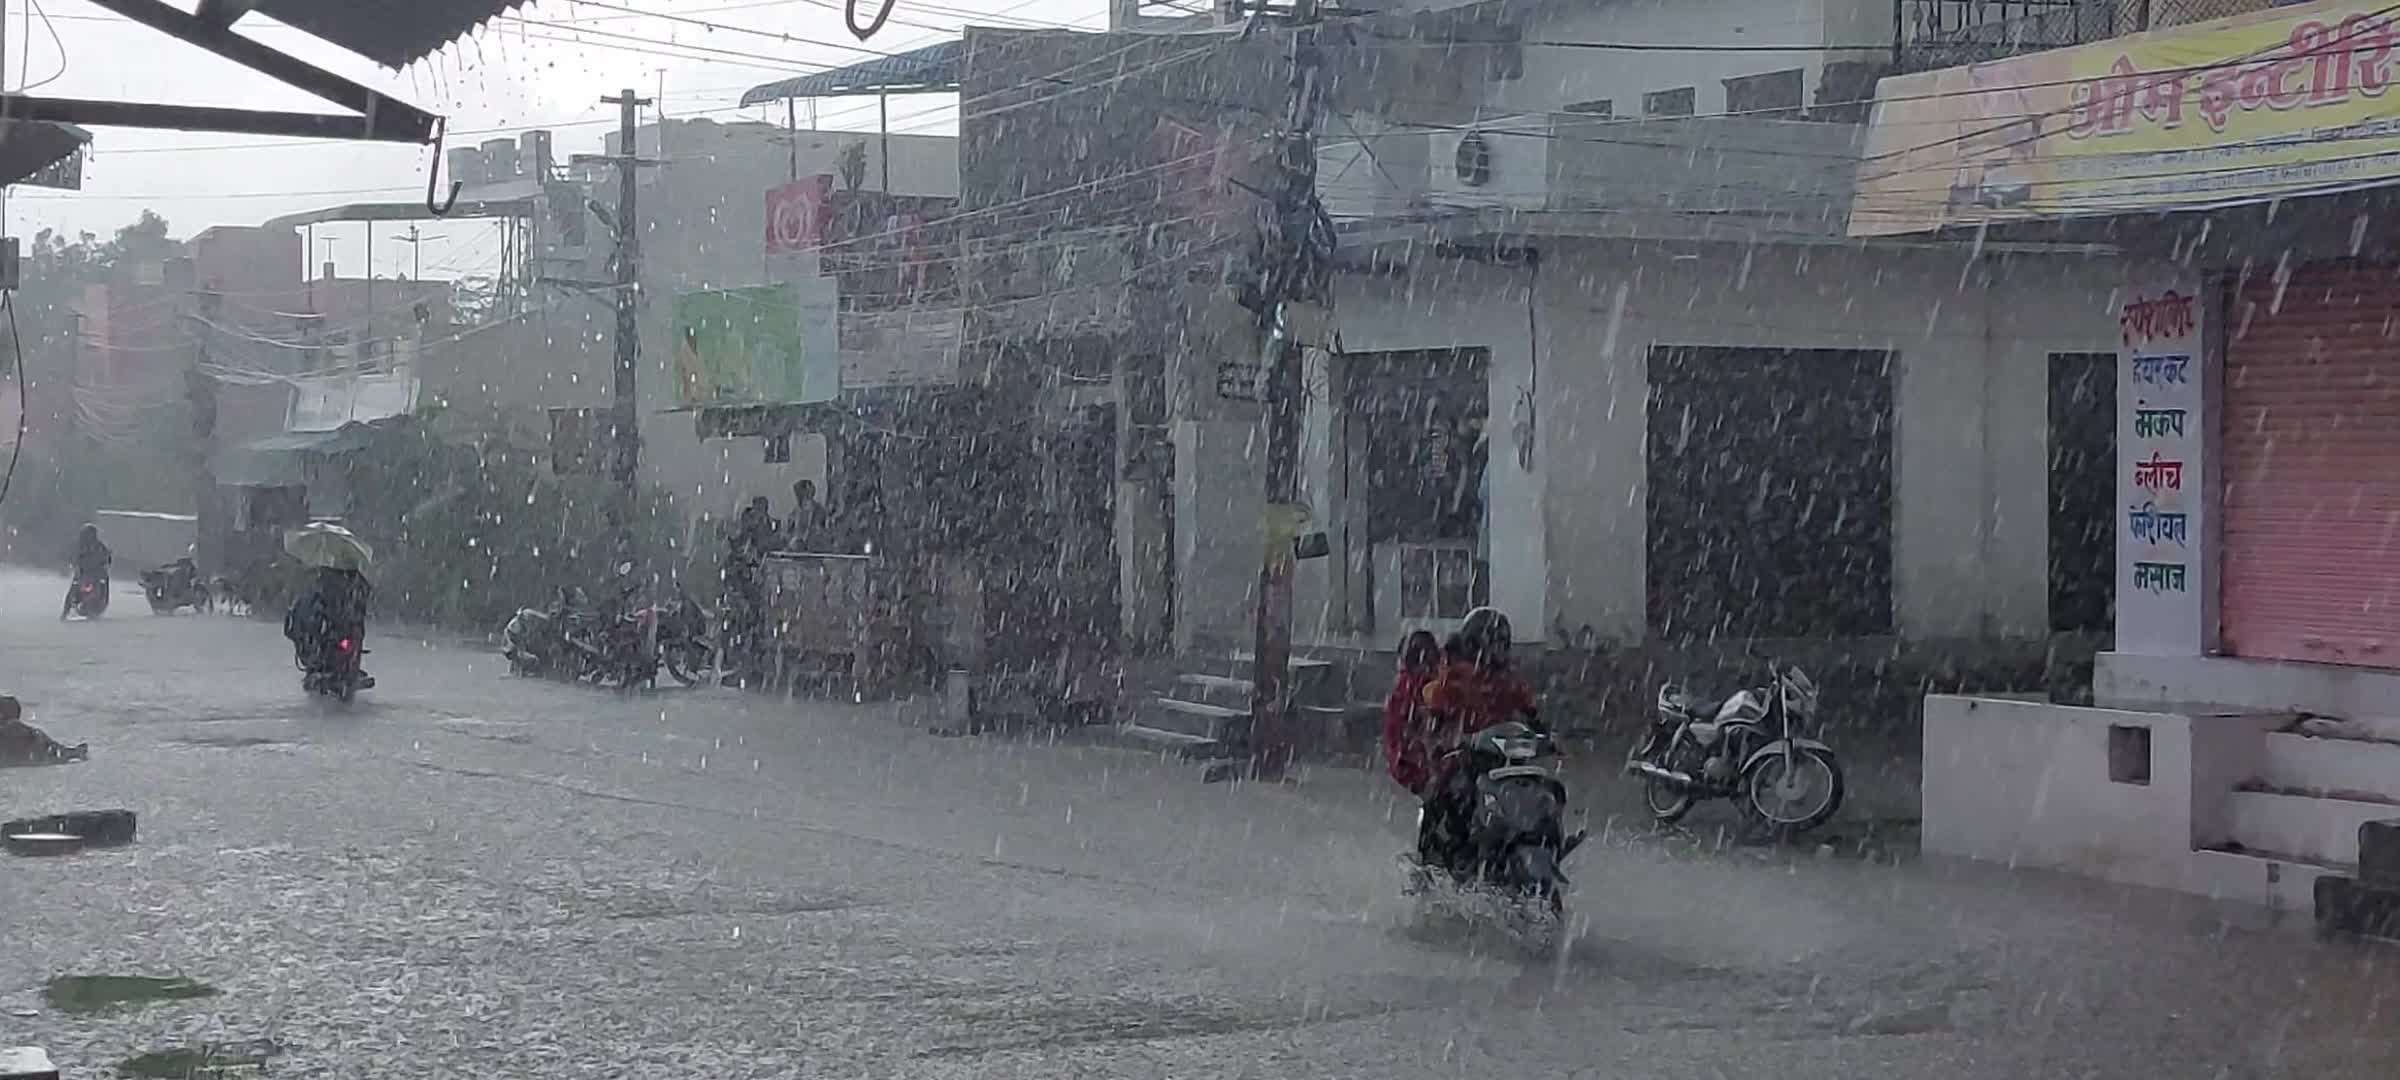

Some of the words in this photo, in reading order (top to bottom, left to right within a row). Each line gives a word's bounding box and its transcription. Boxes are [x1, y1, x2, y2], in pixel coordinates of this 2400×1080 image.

[2067, 53, 2188, 139] ओम
[2199, 12, 2400, 134] इन्टीरि
[2135, 451, 2184, 494] ब्लीच
[2134, 562, 2186, 594] मसाज
